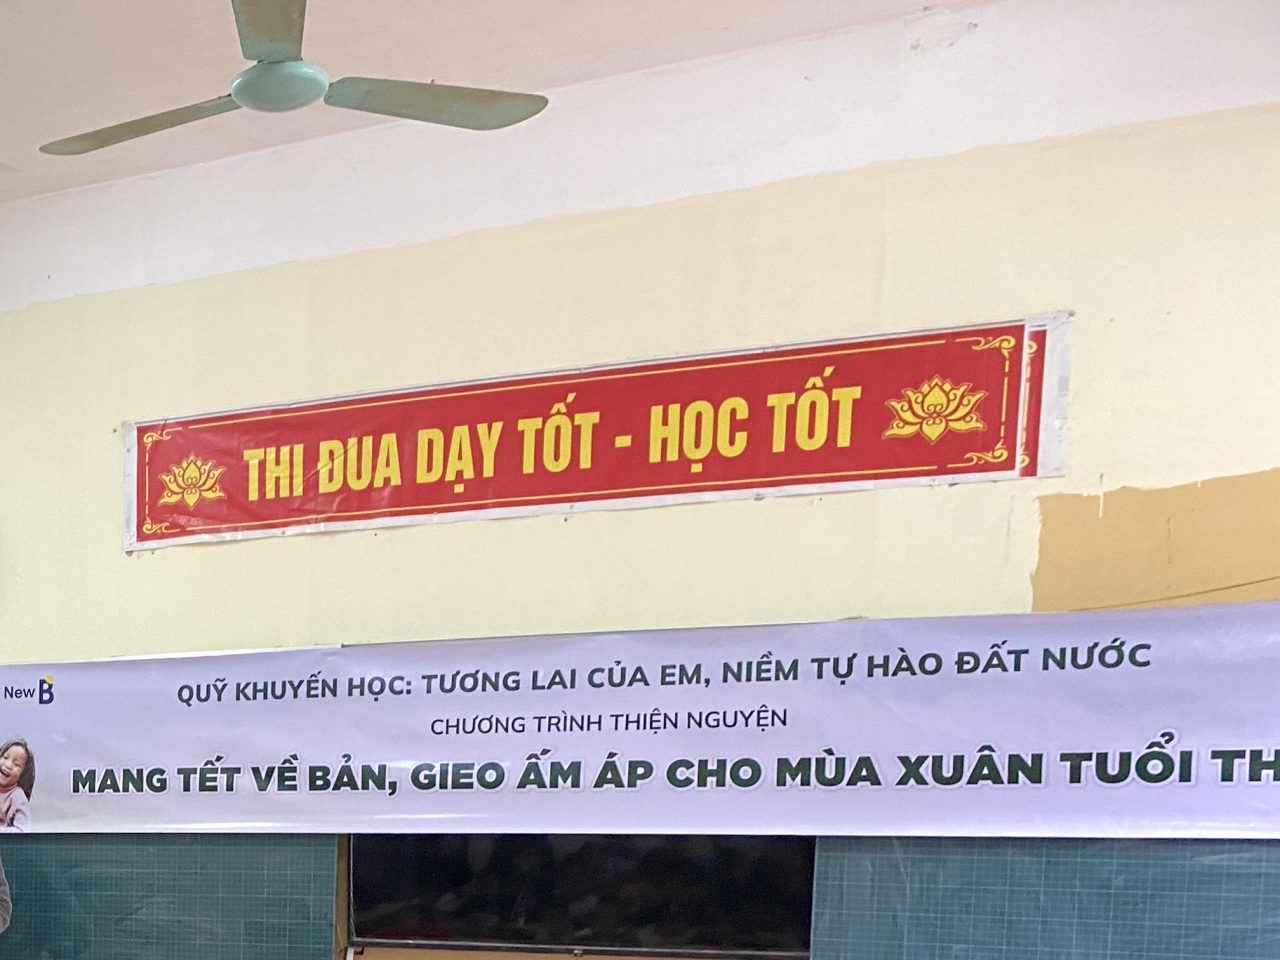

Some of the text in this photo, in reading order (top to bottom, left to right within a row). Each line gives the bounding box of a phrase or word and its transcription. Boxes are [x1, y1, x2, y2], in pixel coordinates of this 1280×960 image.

[243, 443, 304, 501] THI
[317, 433, 402, 494] ĐUA
[416, 421, 504, 493] DẠY
[517, 392, 600, 474] TỐT
[649, 397, 749, 473] HỌC
[767, 365, 862, 453] TỐT
[177, 637, 1151, 706] QUỸ KHUYẾN HỌC: TƯƠNG LAI CỦA EM, NIỀM TỰ HÀO ĐẤT NƯỚC
[430, 705, 787, 735] CHƯƠNG TRÌNH THIỆN NGUYỆN
[72, 768, 167, 793] MANG
[177, 755, 241, 792] TẾT
[251, 753, 299, 792] VỀ
[308, 753, 397, 796] BẢN,
[410, 761, 505, 790] GIEO
[516, 748, 581, 789] ẤM
[593, 752, 653, 788] ÁP
[666, 758, 762, 788] CHO
[776, 748, 882, 787] MÙA
[896, 745, 1043, 786] XUÂN
[1060, 732, 1193, 783] TUỔI
